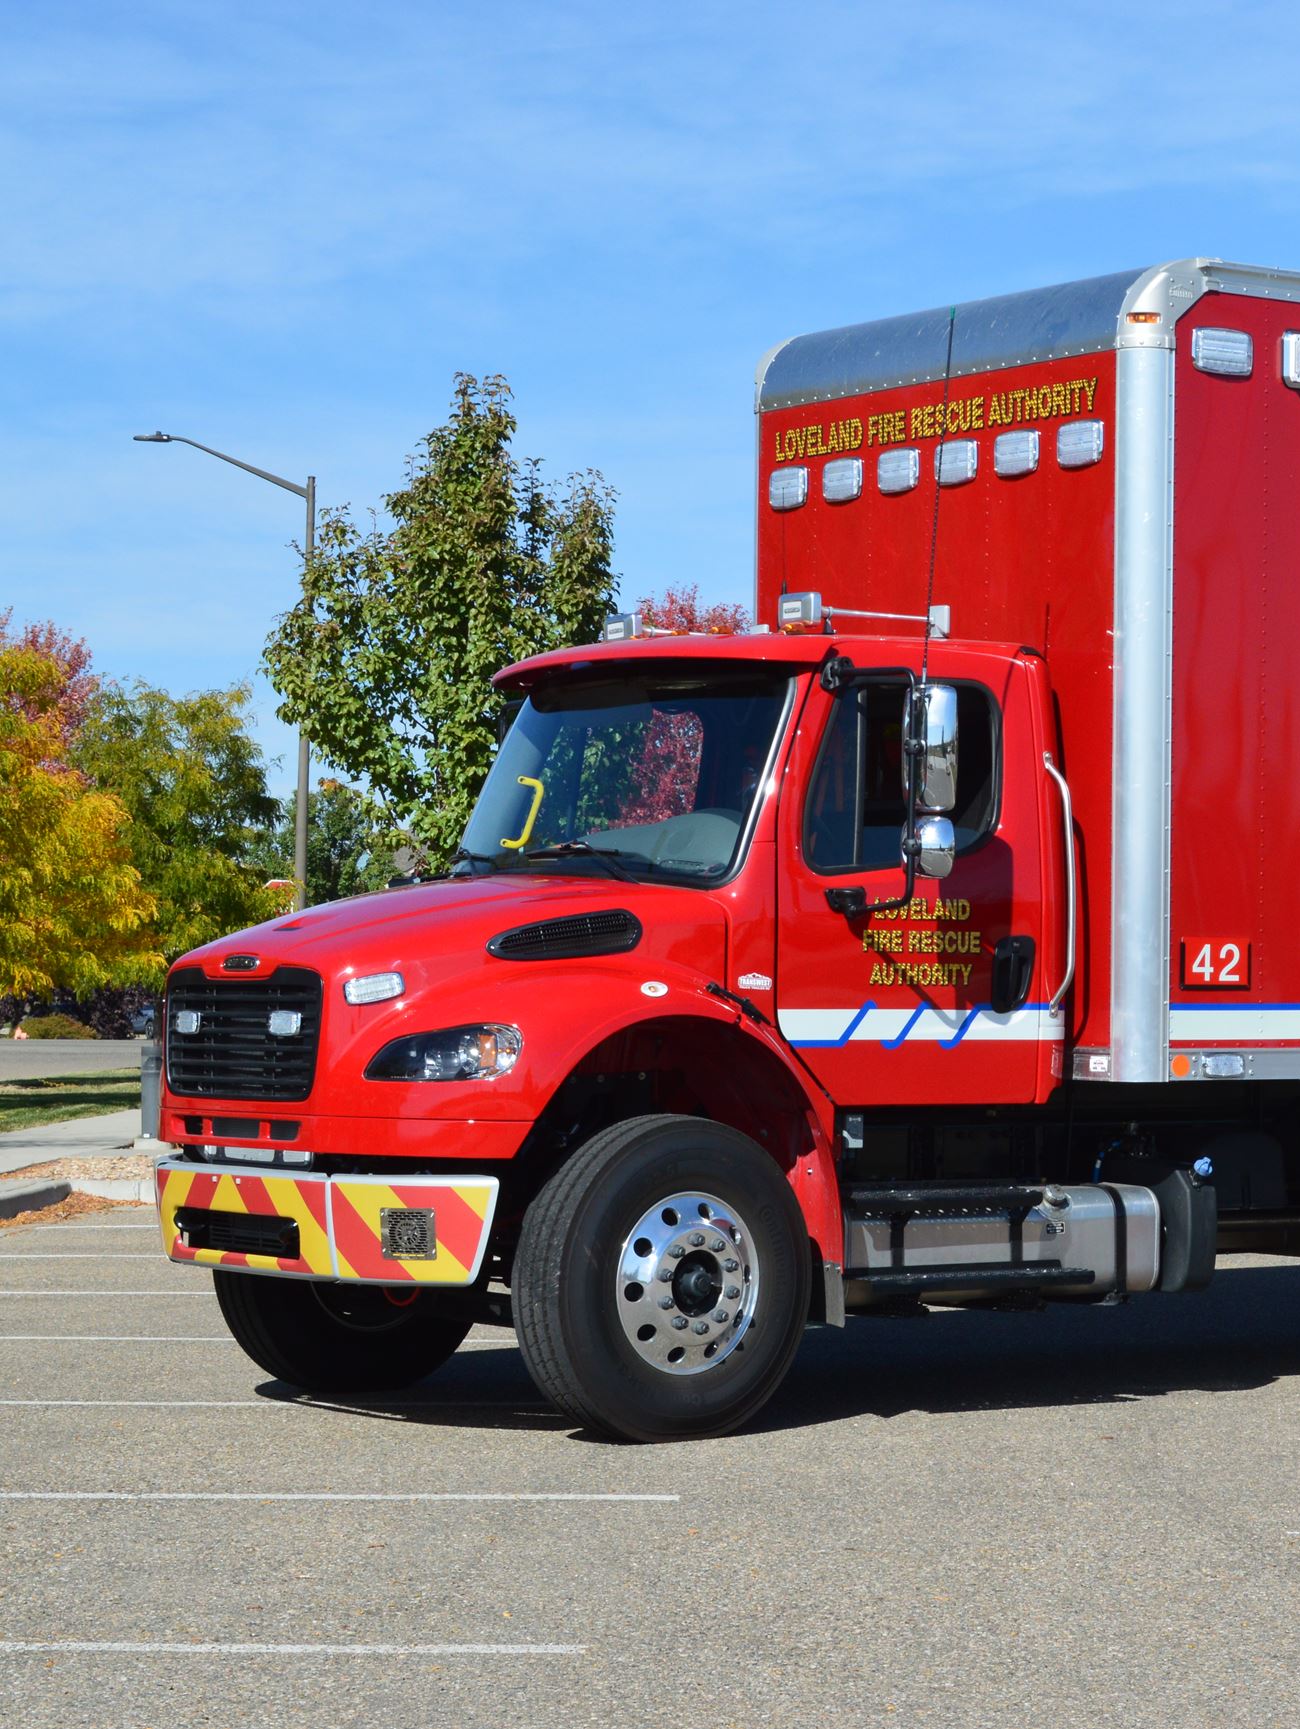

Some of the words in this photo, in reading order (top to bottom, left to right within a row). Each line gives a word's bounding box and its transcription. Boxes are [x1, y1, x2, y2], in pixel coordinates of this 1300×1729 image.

[775, 418, 864, 462] LOVELAND
[867, 410, 906, 447] FIRE
[910, 396, 984, 439] RESCUE
[988, 377, 1098, 428] AUTHORITY
[862, 929, 903, 953] FIRE
[908, 930, 981, 954] RESCUE
[869, 963, 973, 986] AUTHORITY
[1192, 943, 1240, 982] 42
